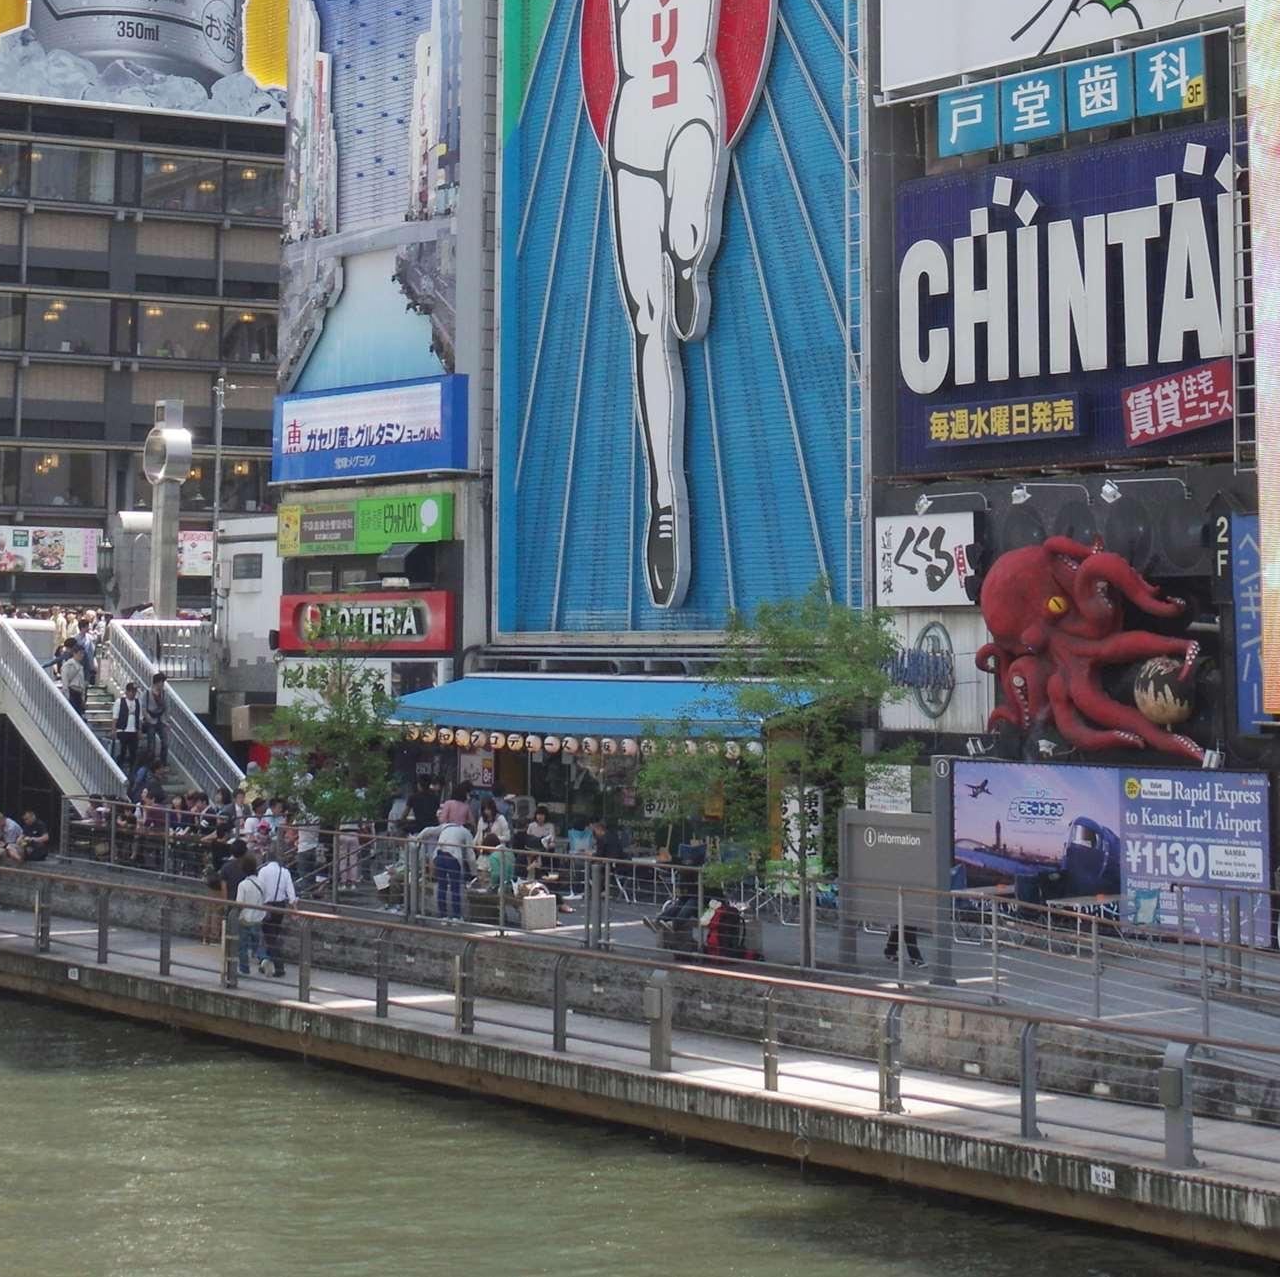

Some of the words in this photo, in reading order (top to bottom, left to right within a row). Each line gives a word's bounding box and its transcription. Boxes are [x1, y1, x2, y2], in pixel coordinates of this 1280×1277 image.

[116, 20, 160, 42] 350ml
[204, 12, 238, 53] お酒
[948, 45, 1192, 145] 戸堂歯科
[1187, 83, 1202, 105] 3F
[928, 398, 1075, 442] 毎週水曜日発売
[1126, 379, 1184, 441] 賃貸
[1181, 369, 1214, 398] 住宅
[1183, 390, 1234, 423] ニュース
[1174, 781, 1211, 807] Rapid
[1214, 783, 1261, 809] Express
[877, 831, 921, 846] information
[1125, 811, 1138, 825] to
[1140, 807, 1183, 828] Kansai
[1215, 812, 1262, 838] Airport
[1125, 839, 1206, 879] ¥1,130
